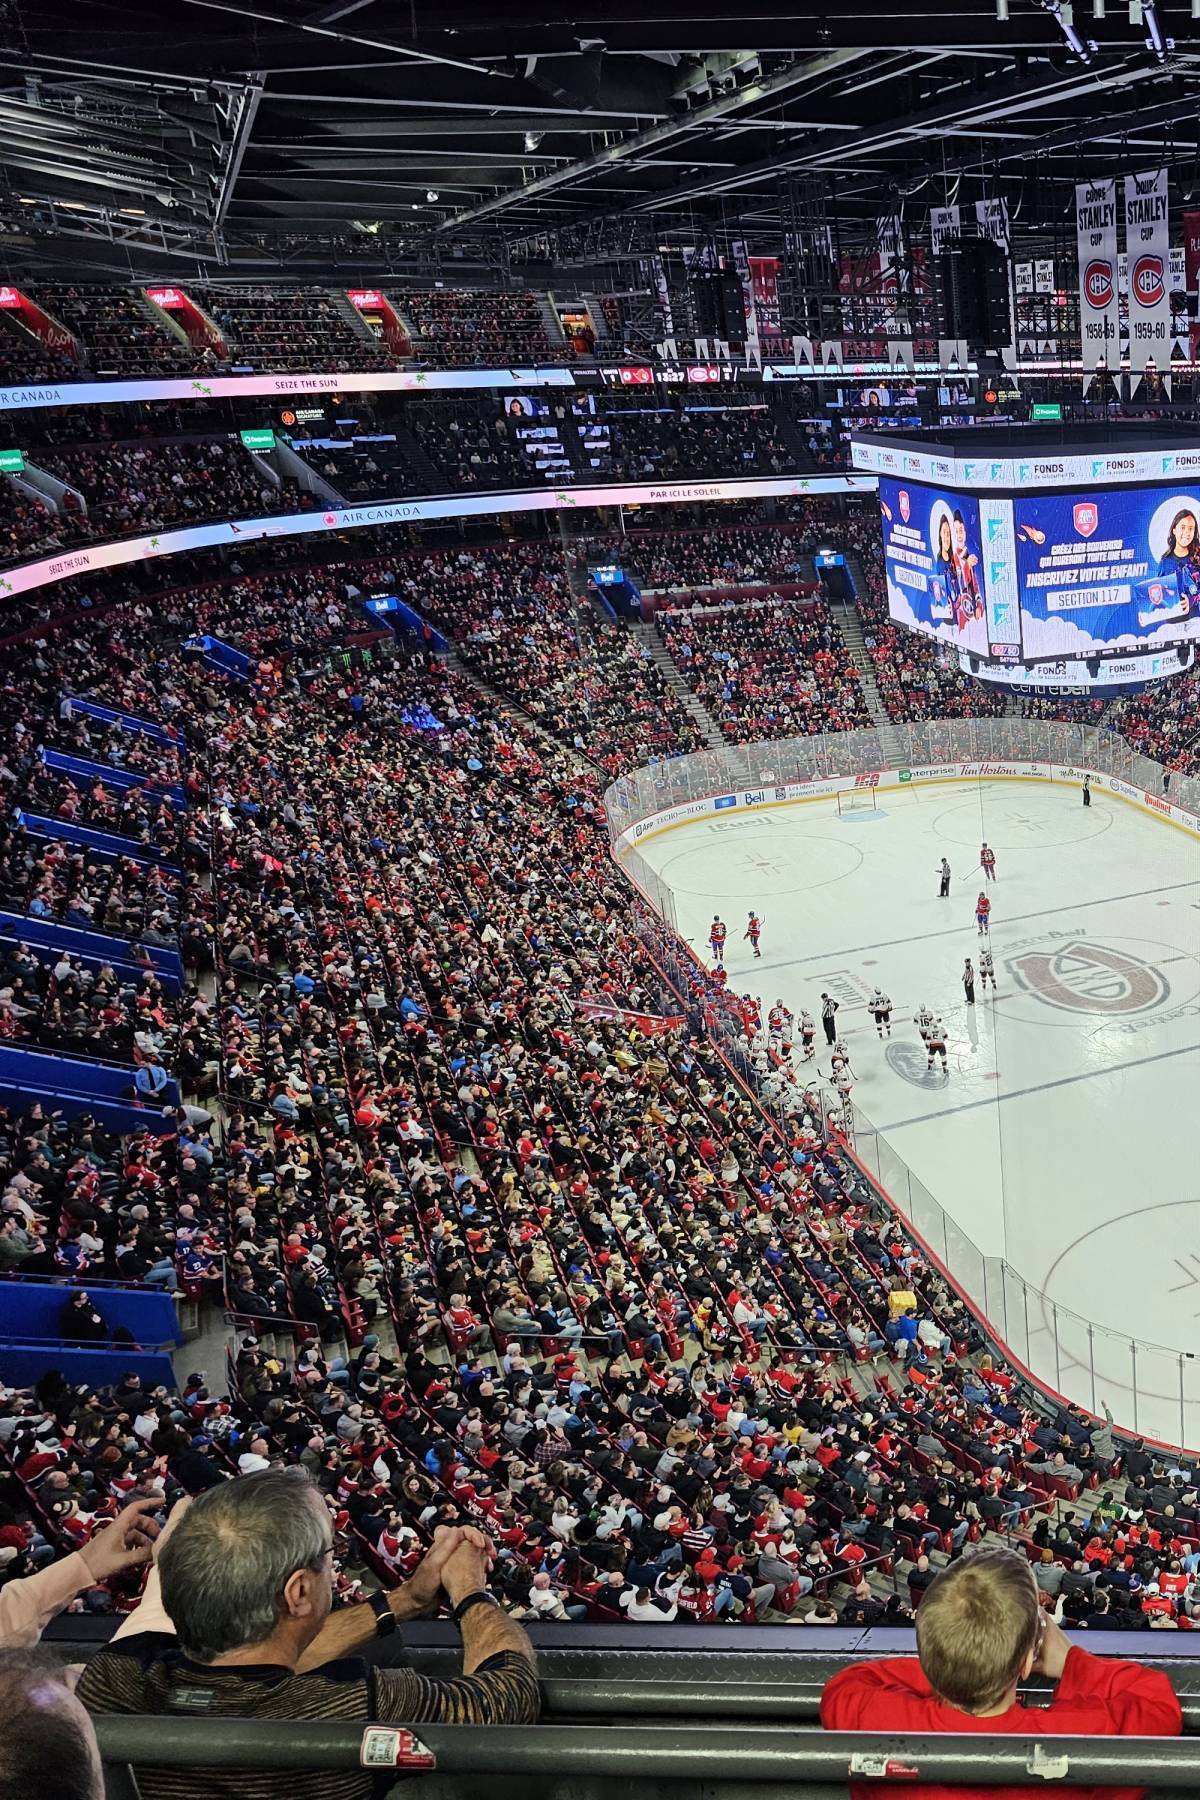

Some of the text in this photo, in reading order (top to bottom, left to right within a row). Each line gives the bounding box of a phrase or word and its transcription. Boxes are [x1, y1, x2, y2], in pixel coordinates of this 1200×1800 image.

[1127, 196, 1167, 225] STANLEY
[1079, 204, 1115, 231] STANLEY
[1090, 233, 1102, 246] CUP
[1140, 227, 1154, 241] CUP
[1134, 322, 1166, 339] 1959-60
[623, 372, 631, 380] 0
[709, 371, 717, 379] 0
[275, 379, 338, 390] SEIZE THE SUN
[12, 389, 62, 404] CANADA
[1034, 464, 1064, 474] FONDS
[1106, 460, 1135, 470] FONDS
[650, 488, 721, 498] PAR ICI LE SOLEIL
[342, 506, 421, 523] AIR CANADA
[49, 555, 90, 575] SEIZE THE SUN
[601, 573, 614, 582] Bell
[1026, 563, 1148, 588] INSCRIVEZ VOTRE ENFANT!
[1058, 589, 1119, 607] SECTION 117
[376, 600, 389, 610] Bell
[1109, 663, 1136, 674] FONDS
[902, 768, 955, 780] enterprise
[960, 765, 980, 776] Tim
[979, 764, 1018, 776] Hortons
[854, 773, 881, 788] IGA
[745, 792, 765, 805] Bell
[1144, 794, 1172, 815] Qualinet
